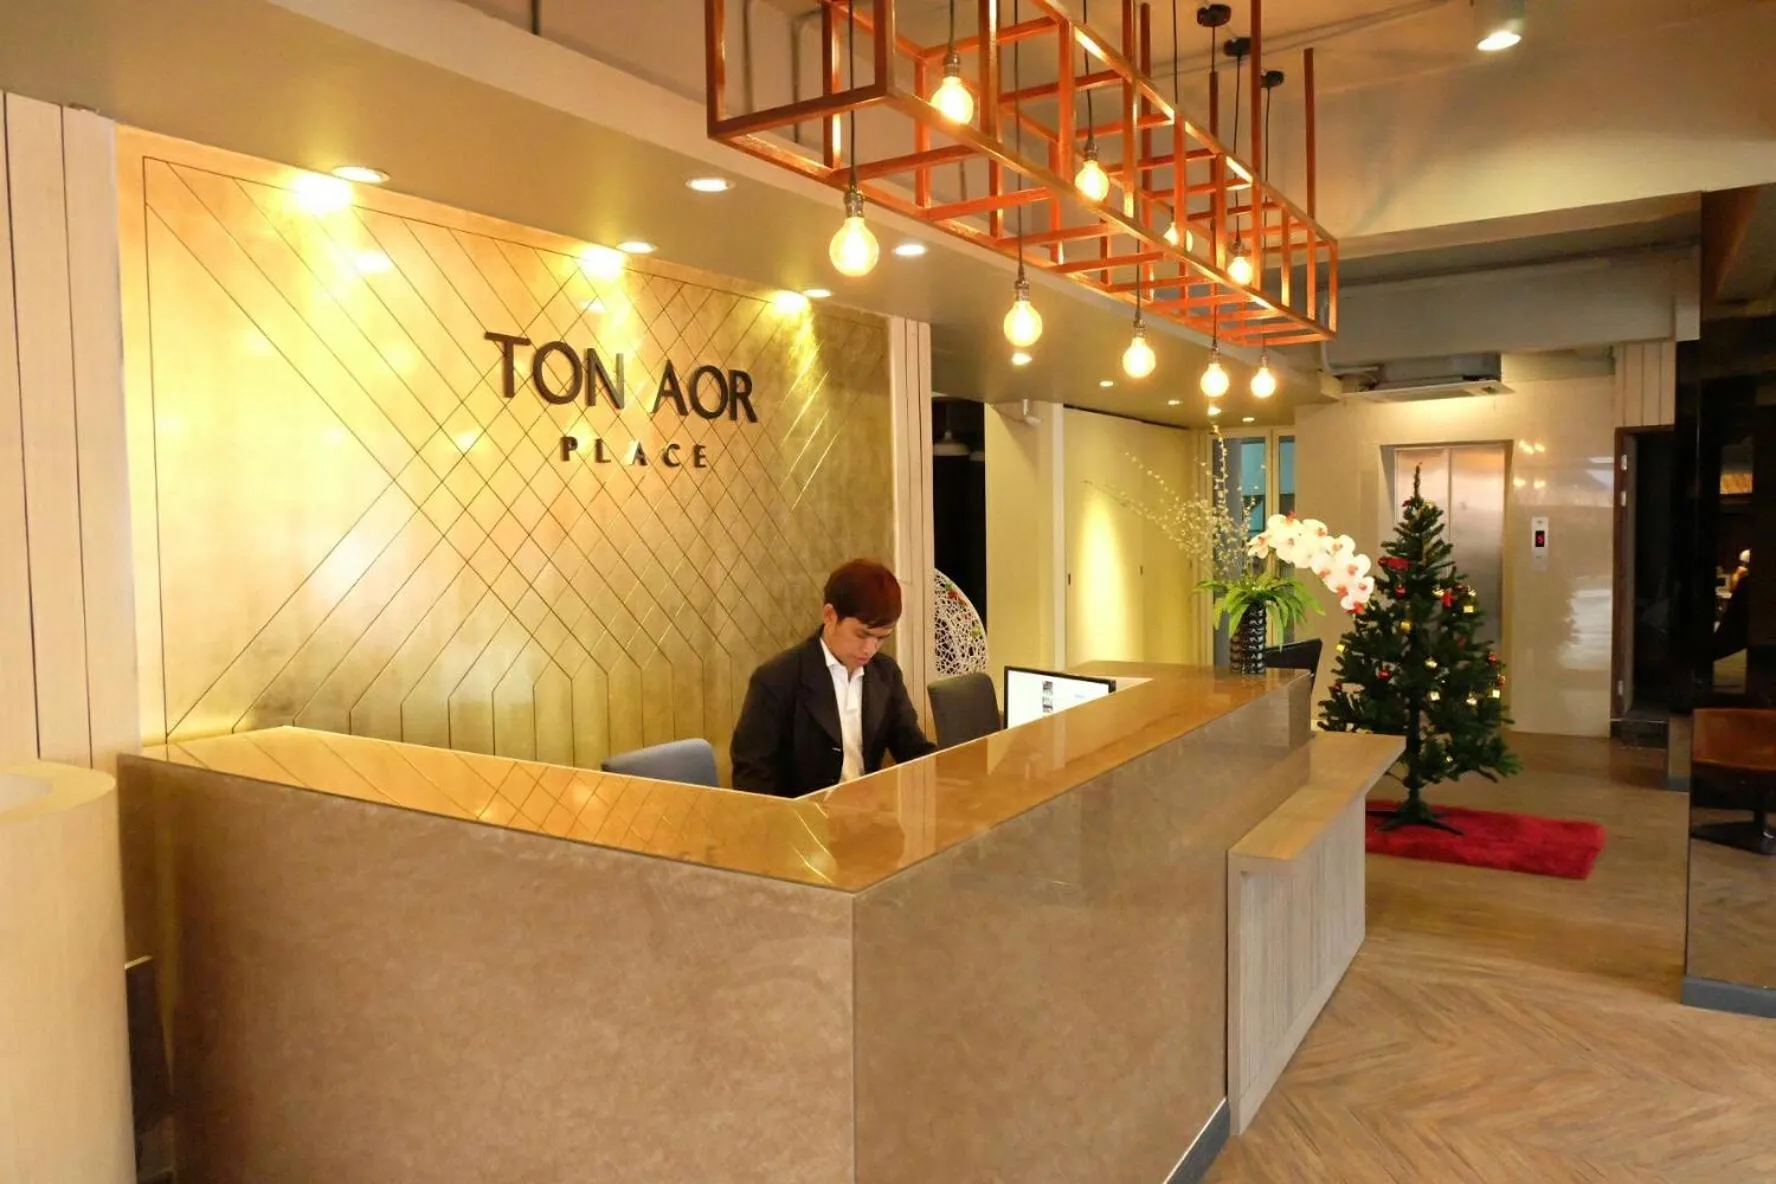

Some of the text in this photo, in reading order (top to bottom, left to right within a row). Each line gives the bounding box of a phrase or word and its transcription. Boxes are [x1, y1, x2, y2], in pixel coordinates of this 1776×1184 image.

[484, 331, 758, 423] TON AOR
[560, 436, 707, 468] PLACE
